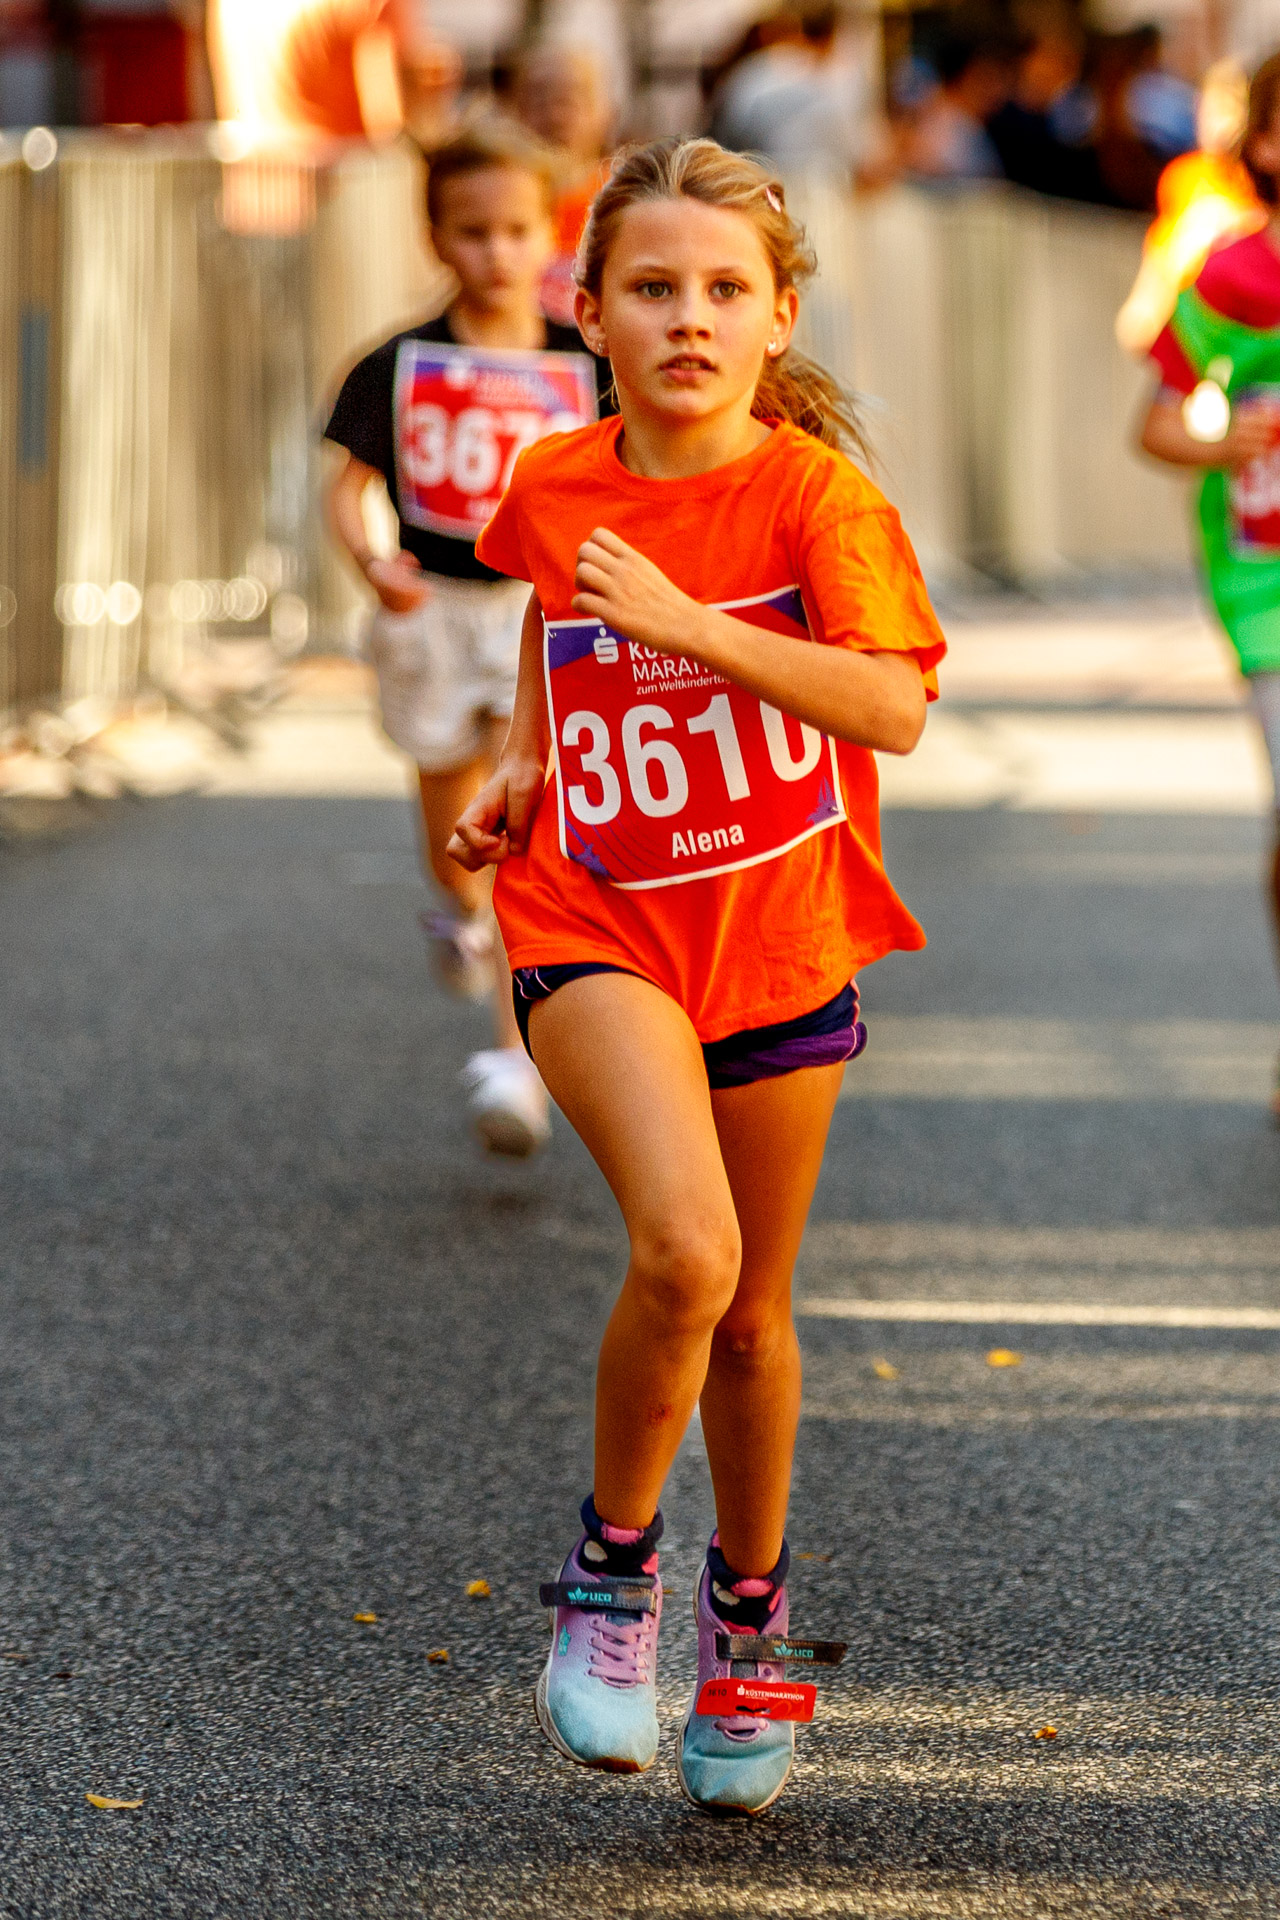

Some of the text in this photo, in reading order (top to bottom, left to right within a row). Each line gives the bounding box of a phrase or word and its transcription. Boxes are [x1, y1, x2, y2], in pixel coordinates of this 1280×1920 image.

[404, 403, 580, 496] 367
[636, 685, 658, 695] zum
[562, 693, 822, 825] 3610
[672, 824, 745, 858] Alena
